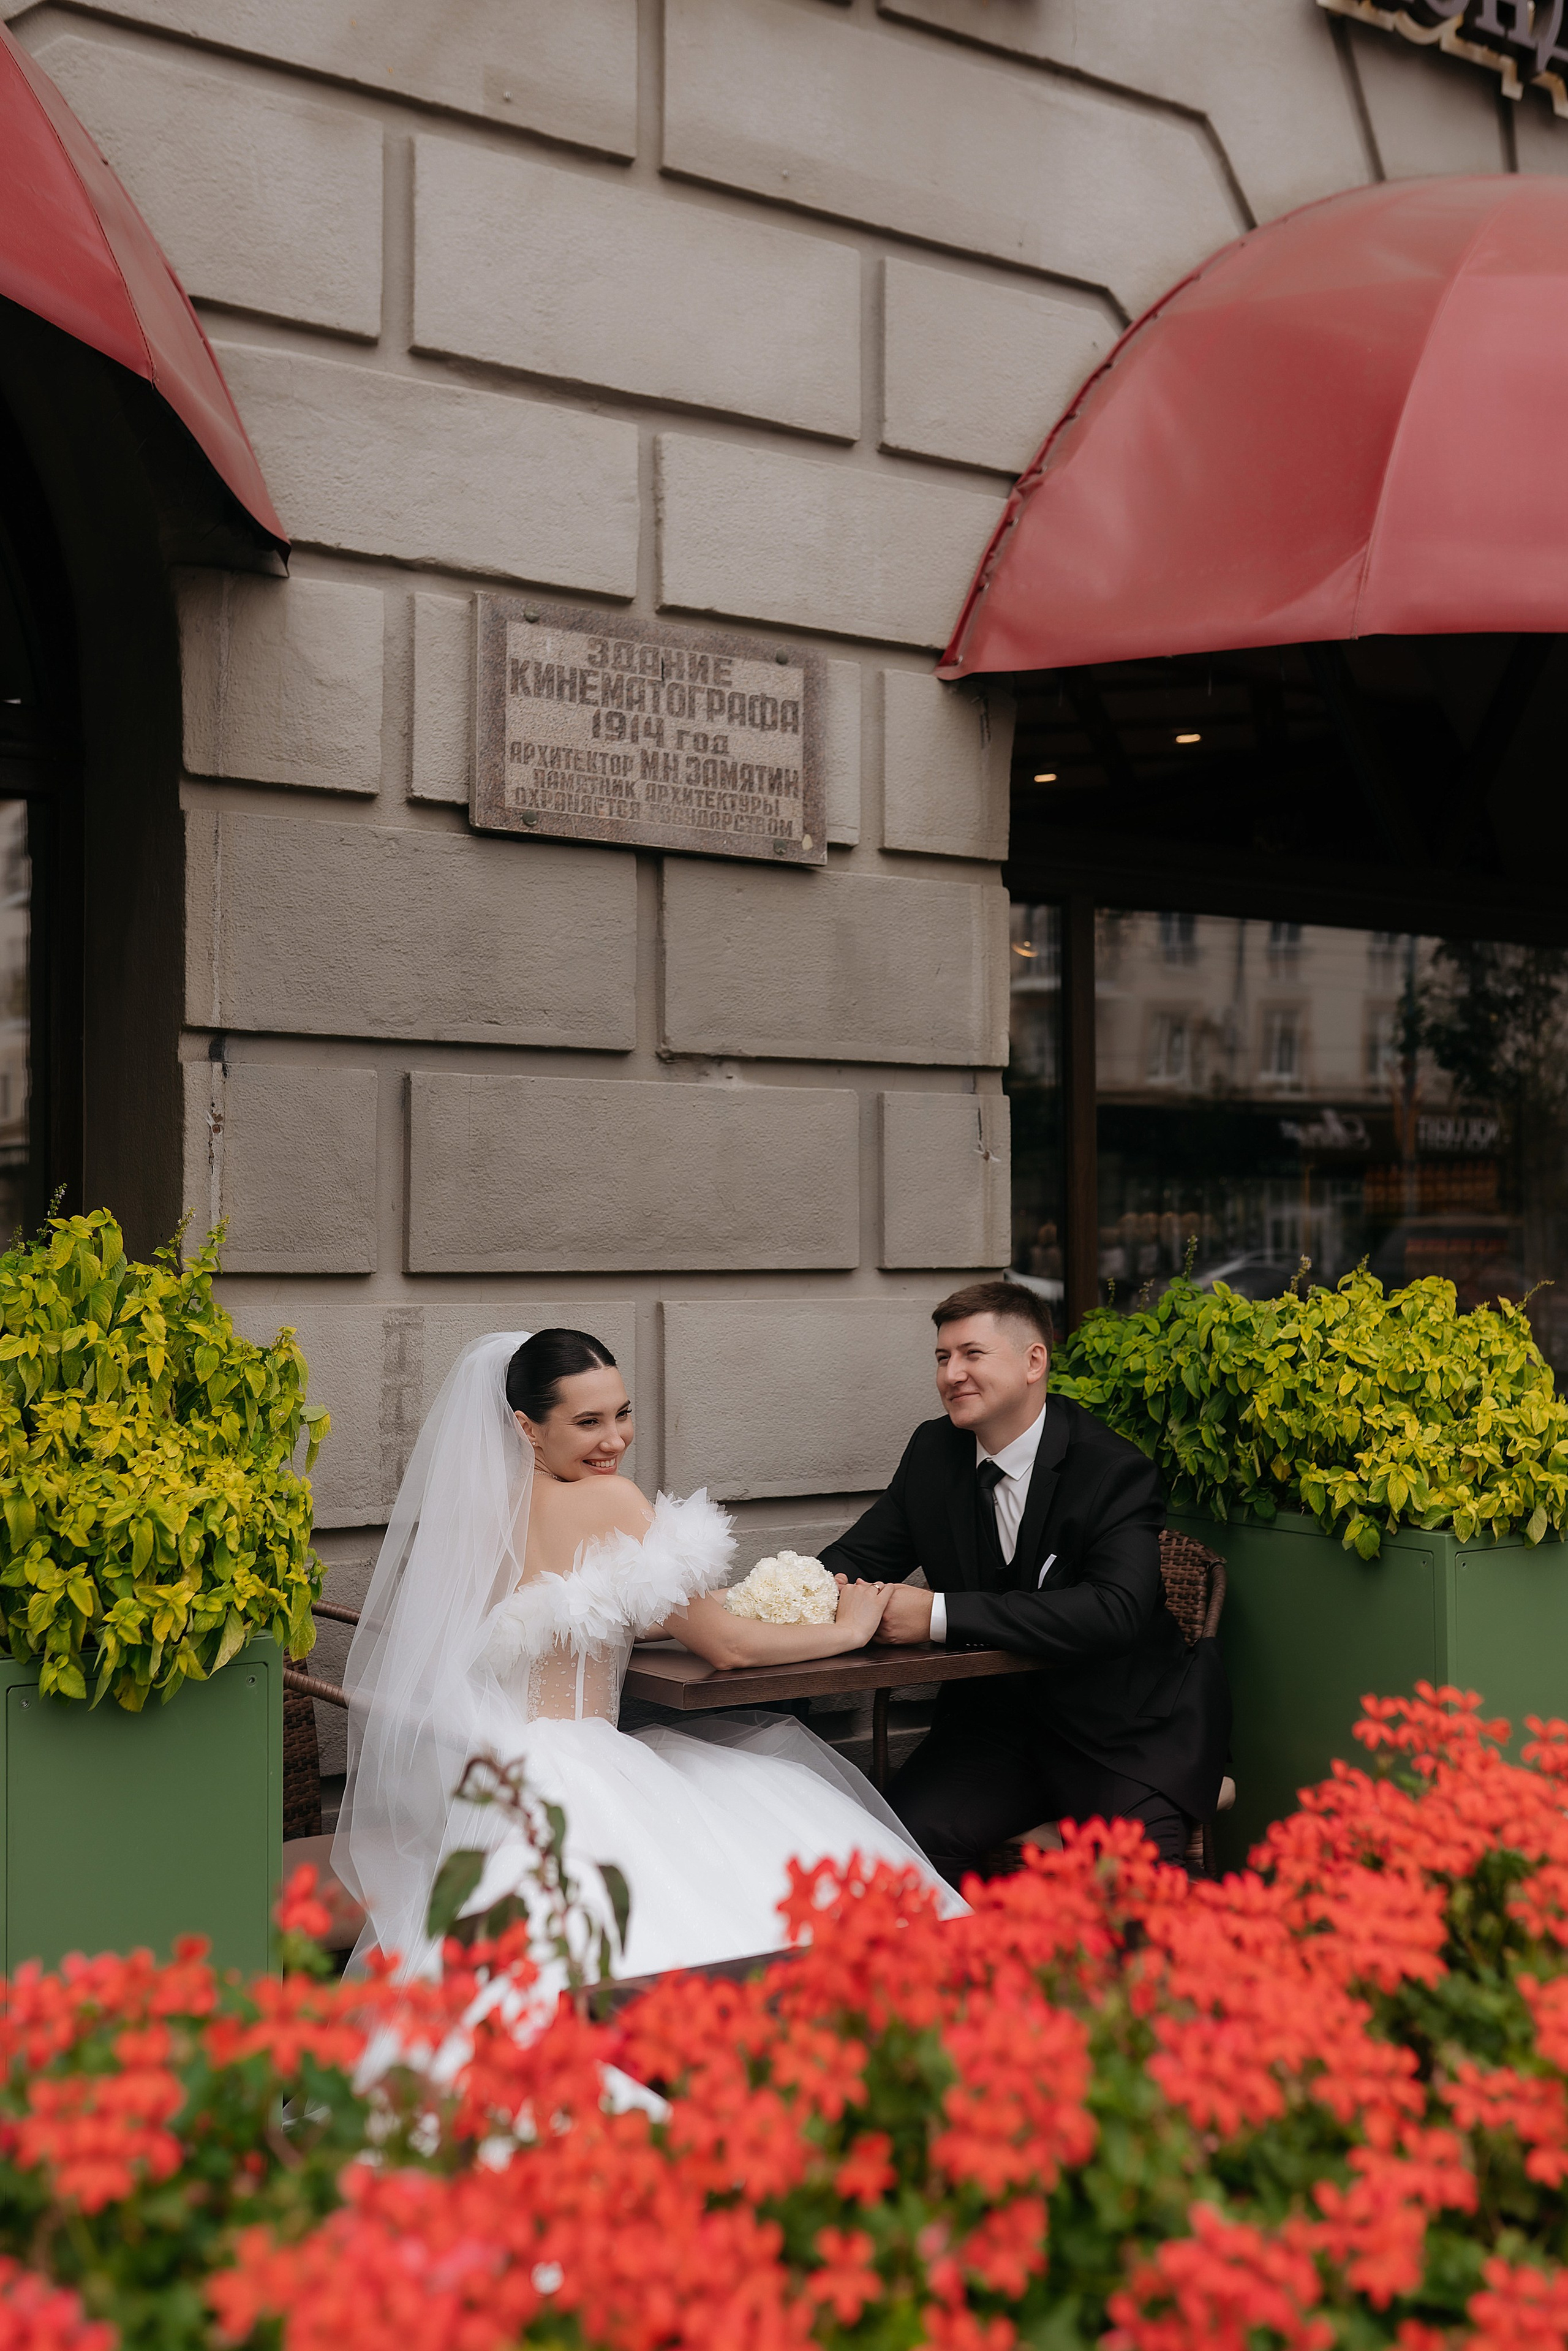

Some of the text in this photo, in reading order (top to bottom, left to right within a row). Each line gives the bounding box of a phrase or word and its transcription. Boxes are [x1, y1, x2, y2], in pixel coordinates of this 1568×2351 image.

[586, 635, 734, 686] ЗДАНИЕ
[508, 658, 800, 734] КИНЕМАТОГРАФА
[592, 709, 665, 748] 1914
[510, 741, 635, 777] АРХИТЕКТОР
[514, 787, 794, 838] ОХРАНЯЕТСЯ ГОСУДАРСТВОМ
[533, 768, 781, 818] ПАМЯТНИК АРХИТЕКТУРЫ
